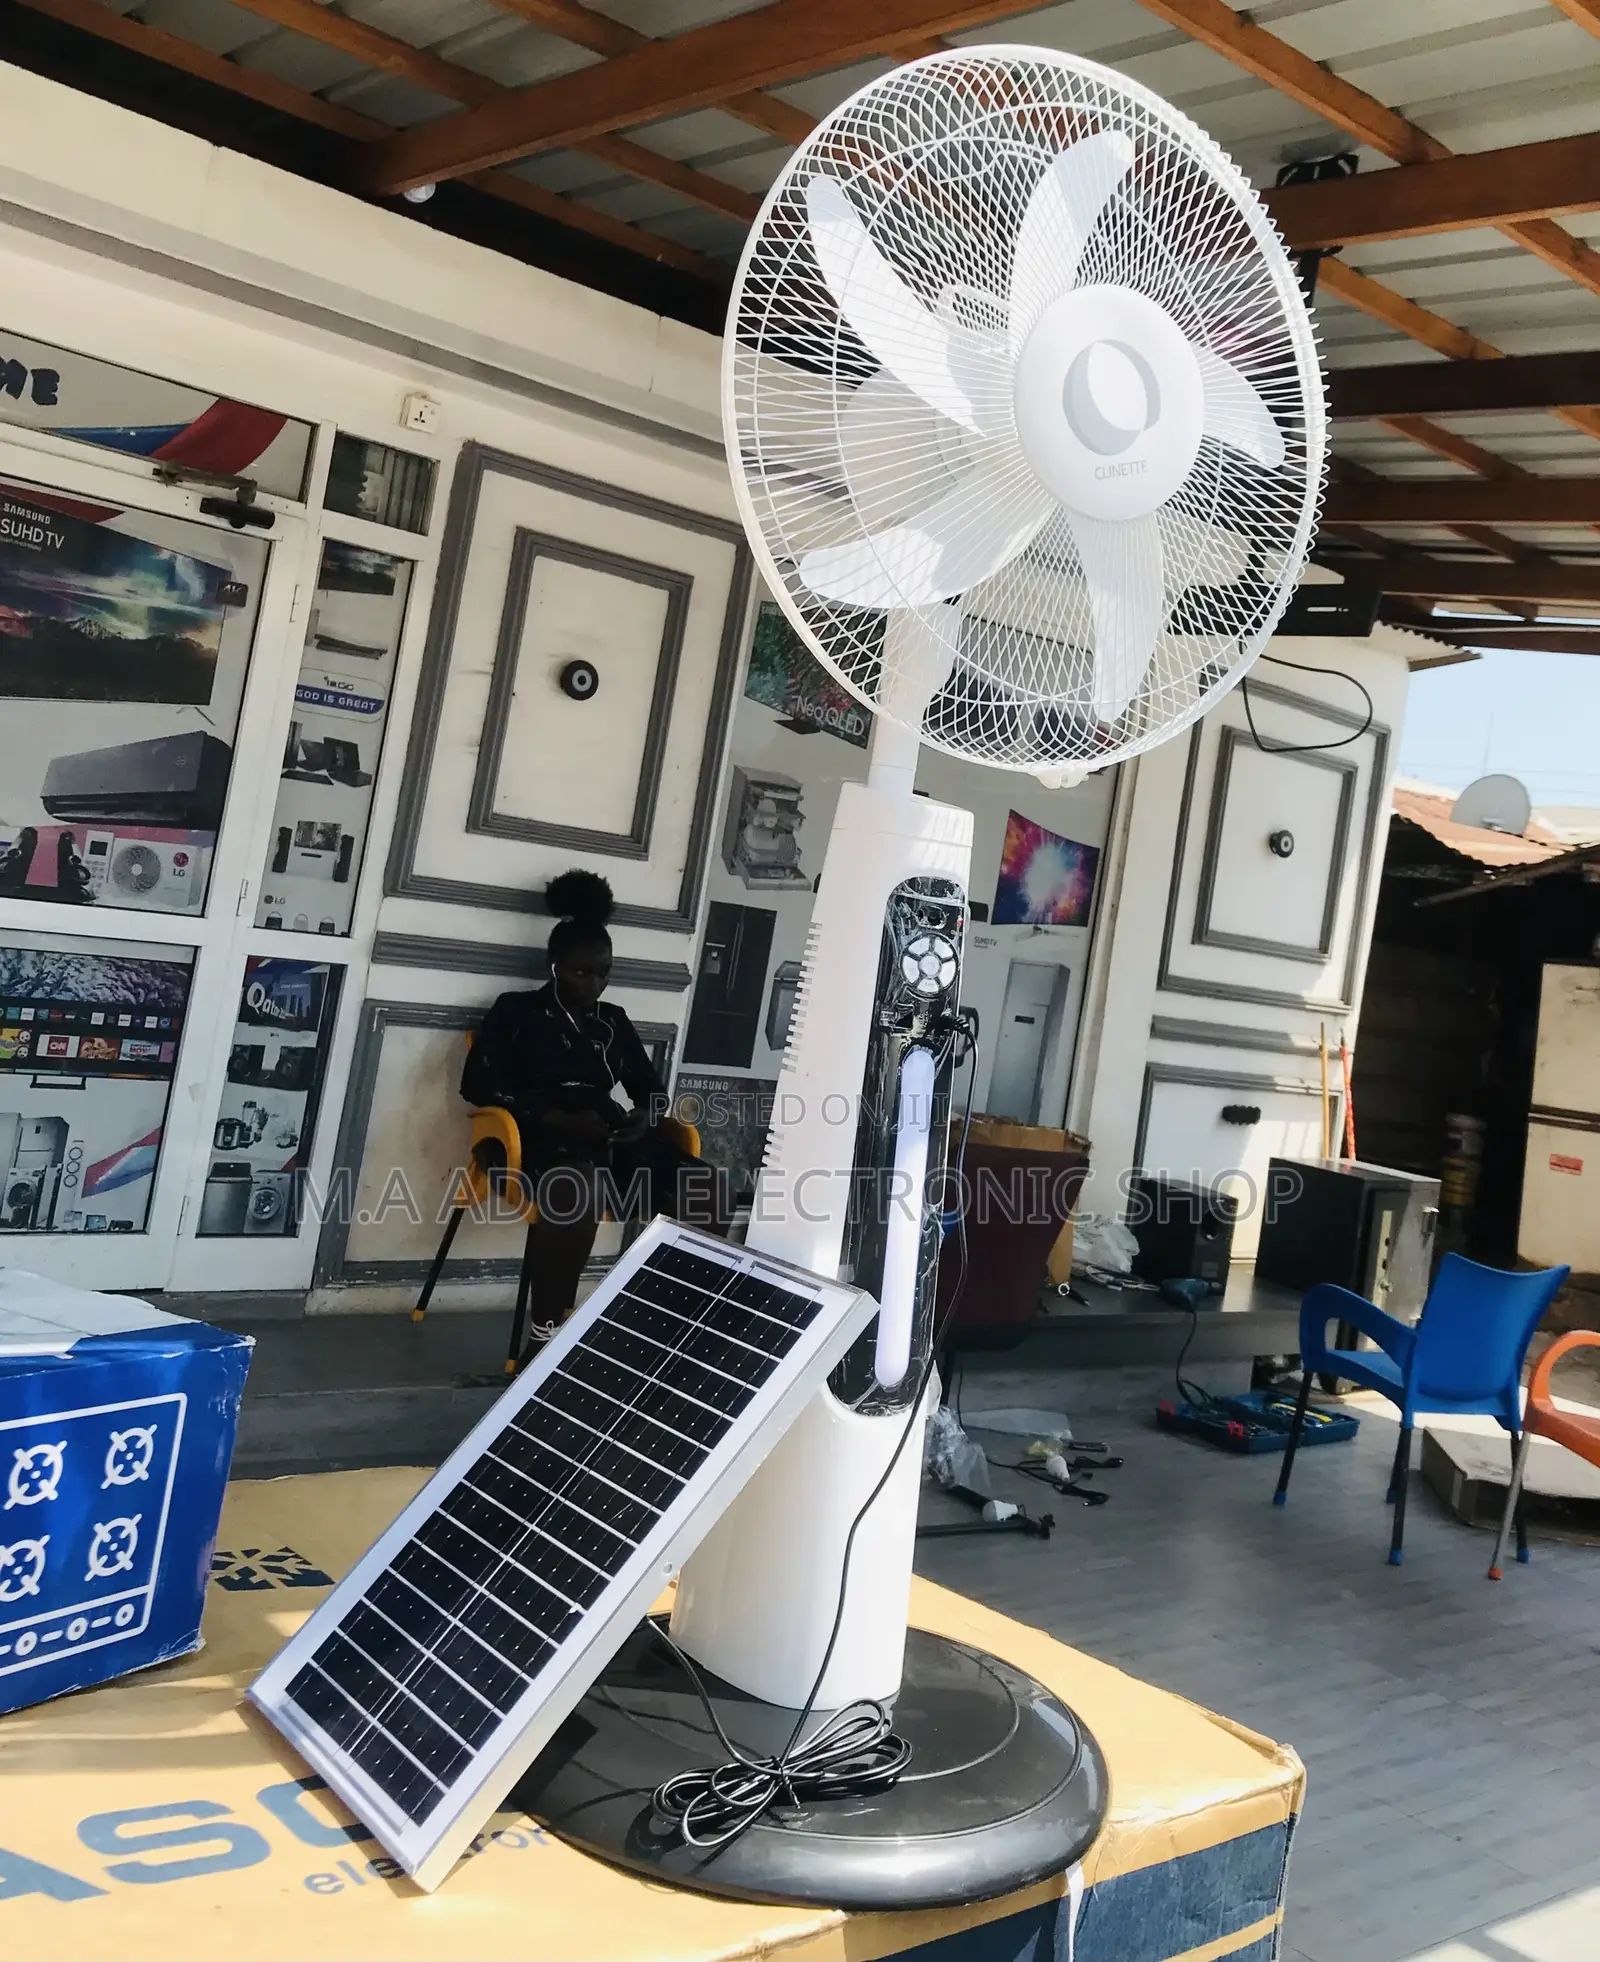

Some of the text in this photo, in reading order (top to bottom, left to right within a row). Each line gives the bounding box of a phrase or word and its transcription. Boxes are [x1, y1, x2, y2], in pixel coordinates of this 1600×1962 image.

[3, 502, 51, 525] SAMSUNG
[296, 689, 376, 711] GOD IS GREAT
[173, 868, 186, 878] LG
[679, 1077, 730, 1093] SAMSUNG
